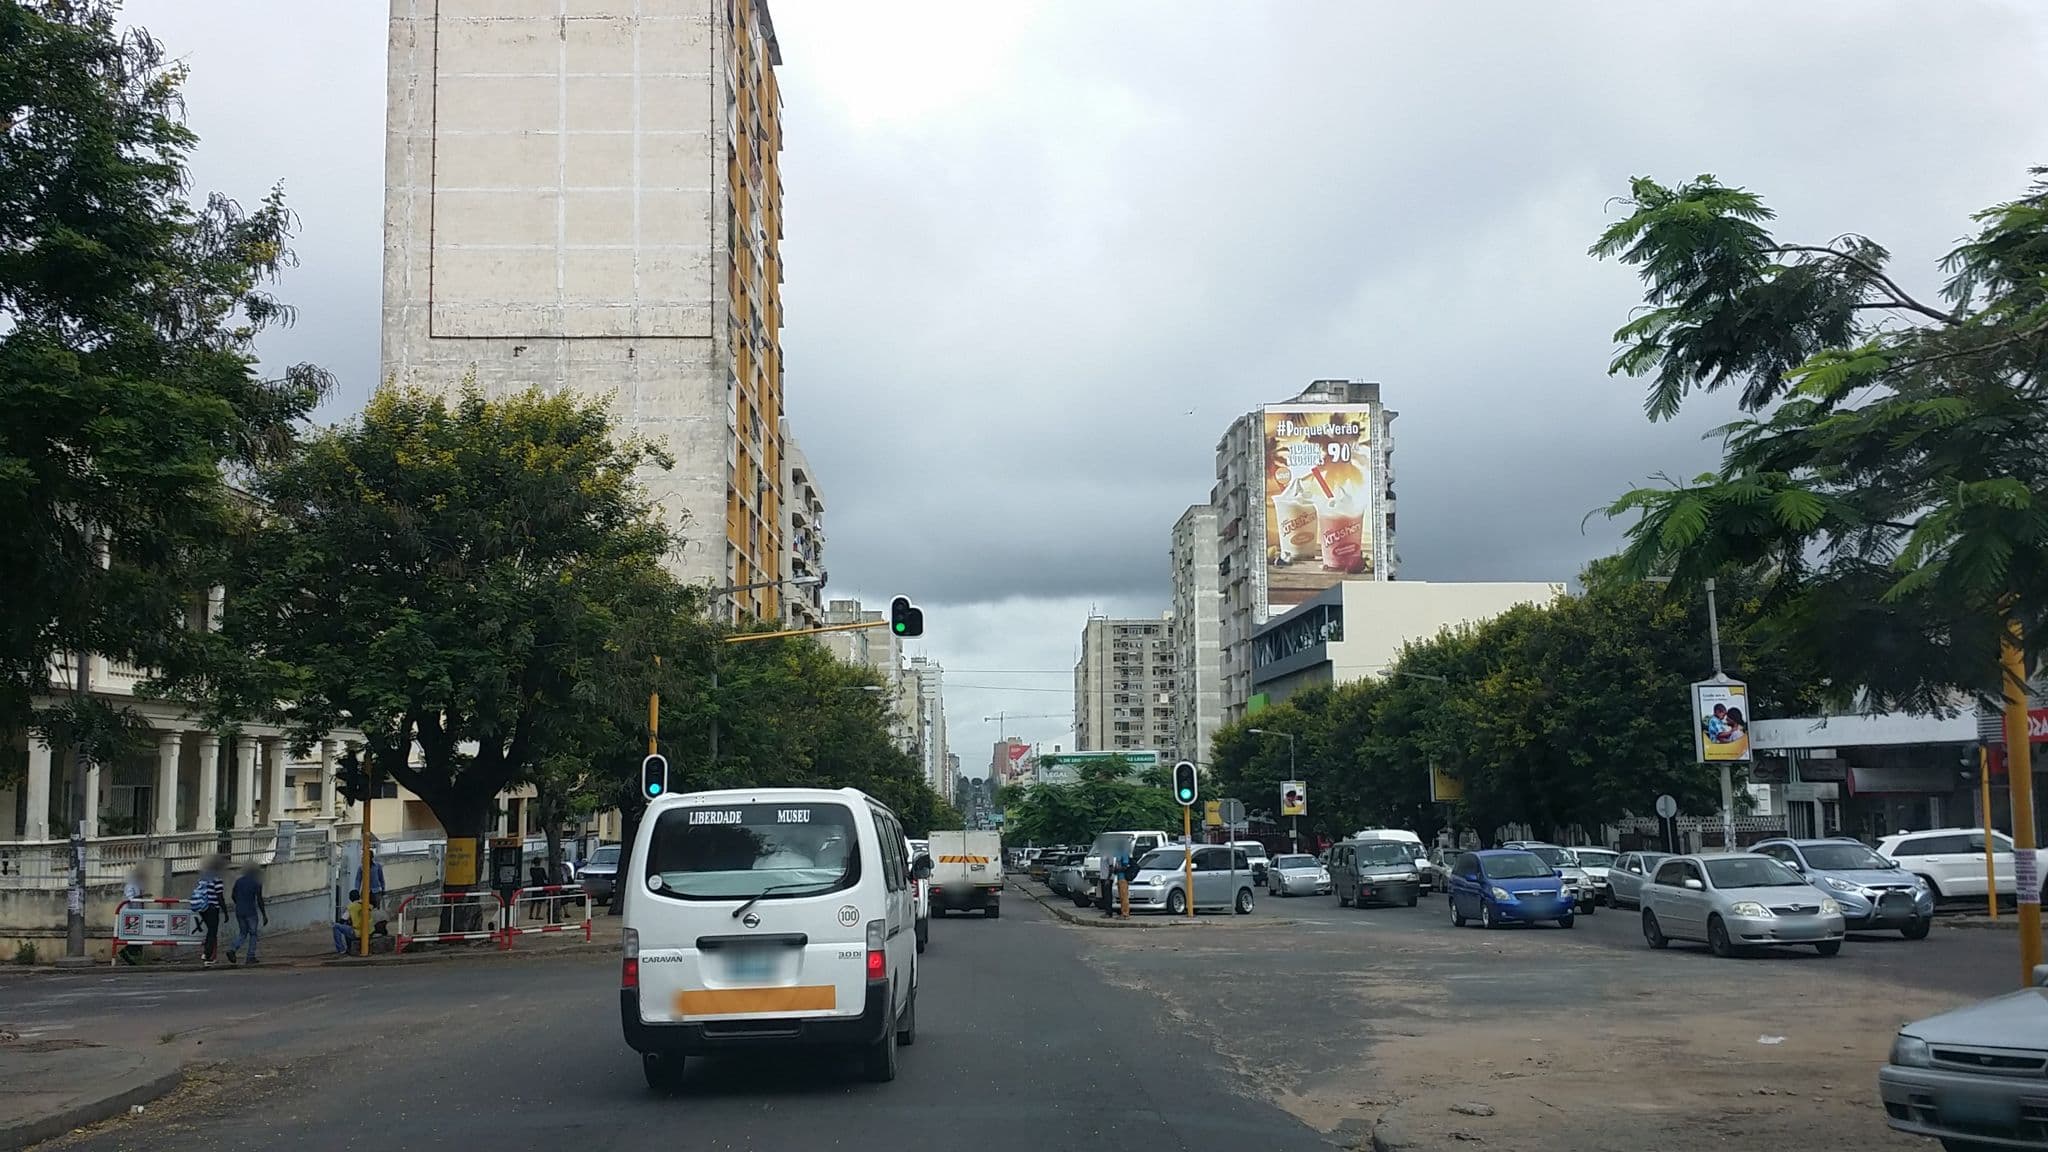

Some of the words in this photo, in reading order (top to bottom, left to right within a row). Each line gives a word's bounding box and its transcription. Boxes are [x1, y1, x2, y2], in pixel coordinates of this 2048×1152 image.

[689, 811, 742, 825] LIBERDADE
[777, 809, 810, 823] MUSEU
[841, 910, 857, 921] 100
